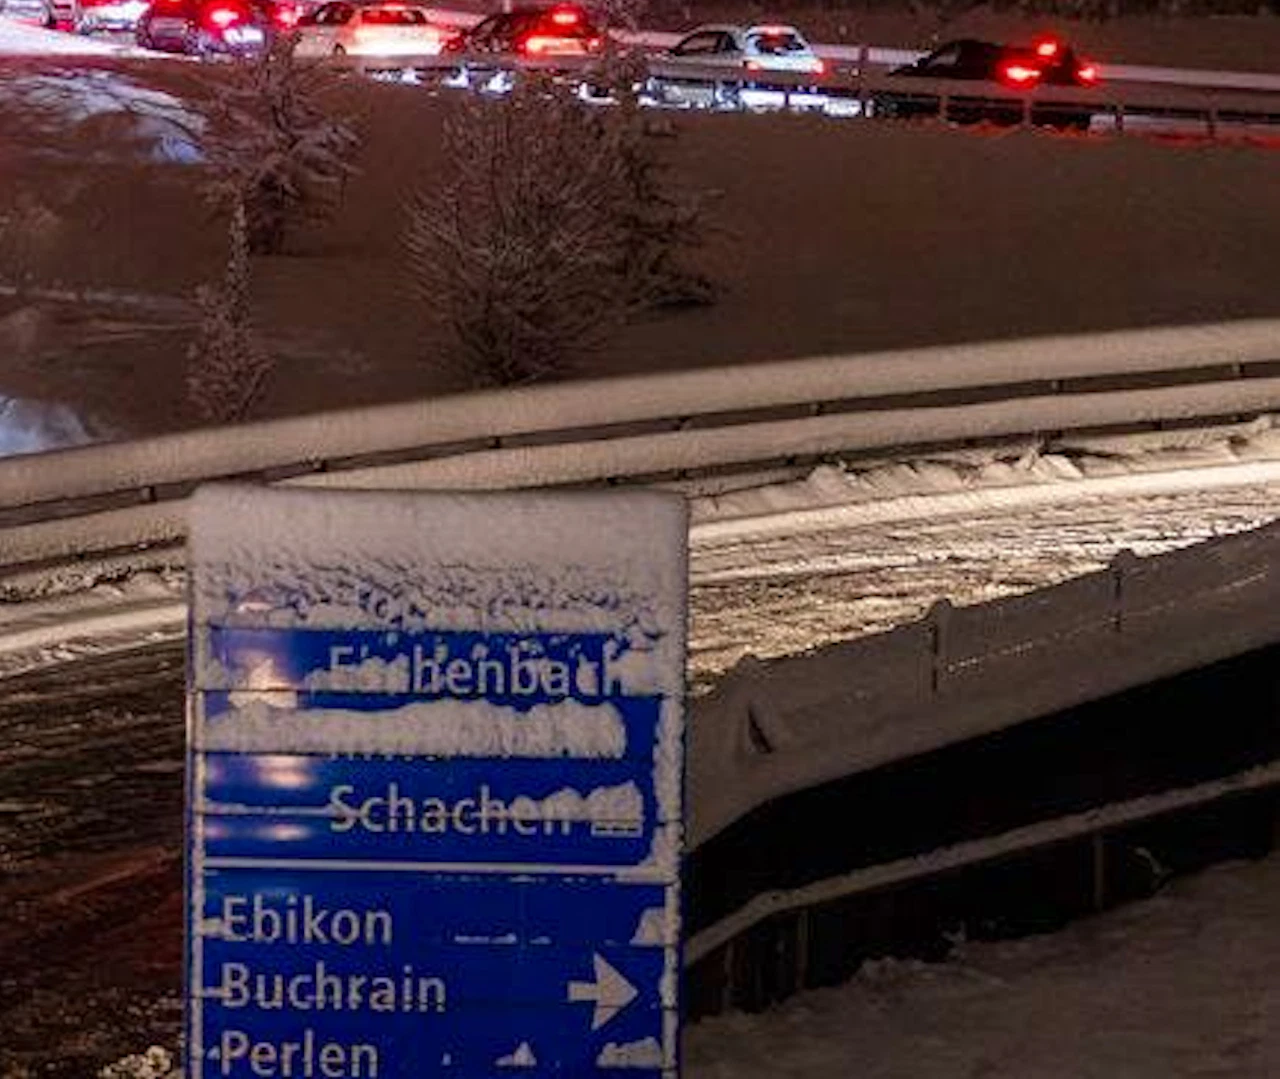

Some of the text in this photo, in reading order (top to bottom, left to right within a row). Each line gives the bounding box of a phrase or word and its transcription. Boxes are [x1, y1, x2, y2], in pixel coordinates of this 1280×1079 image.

[329, 640, 630, 696] Ehenbah
[223, 894, 393, 945] Ebikon
[221, 960, 447, 1013] Buchrain
[221, 1028, 379, 1078] Perlen
